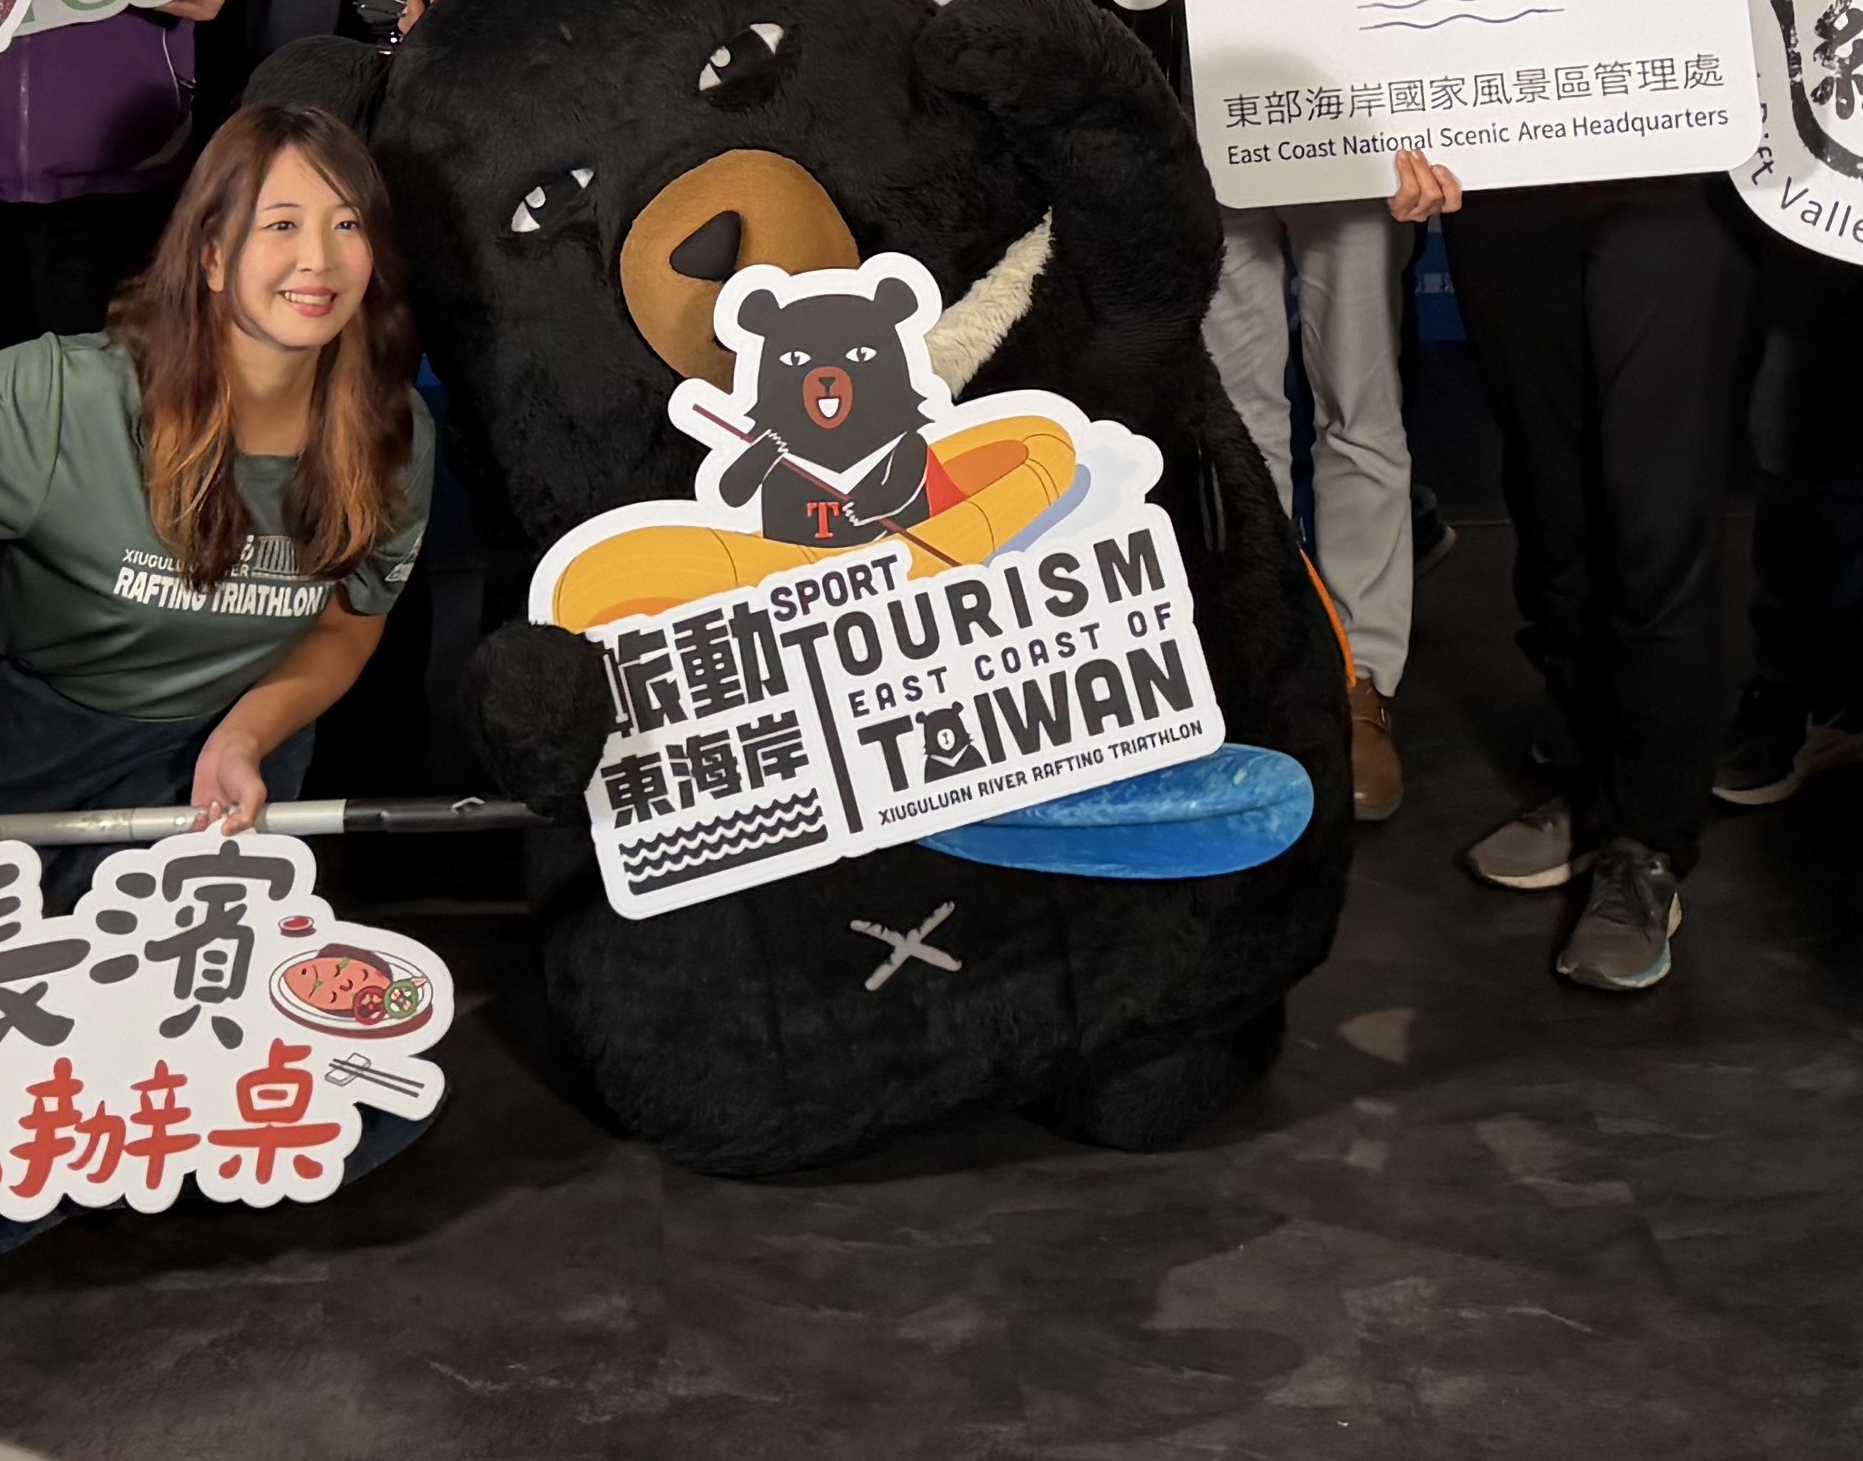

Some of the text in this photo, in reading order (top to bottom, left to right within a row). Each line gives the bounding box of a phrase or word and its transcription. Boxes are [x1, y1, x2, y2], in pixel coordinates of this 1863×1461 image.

[1223, 53, 1724, 128] 東部海岸國家風景區管理處
[1227, 107, 1729, 165] East Coast National Scenic Area Headquarters
[807, 501, 841, 539] T
[113, 566, 324, 618] RAFTING TRIATHLON
[771, 554, 900, 623] SPORT
[781, 528, 1166, 700] TOURISM
[847, 601, 1175, 717] EAST COAST OF
[600, 709, 810, 830] 東海岸
[878, 719, 1203, 827] XIUGULUAN RIVER RAFTING TRIATHLON
